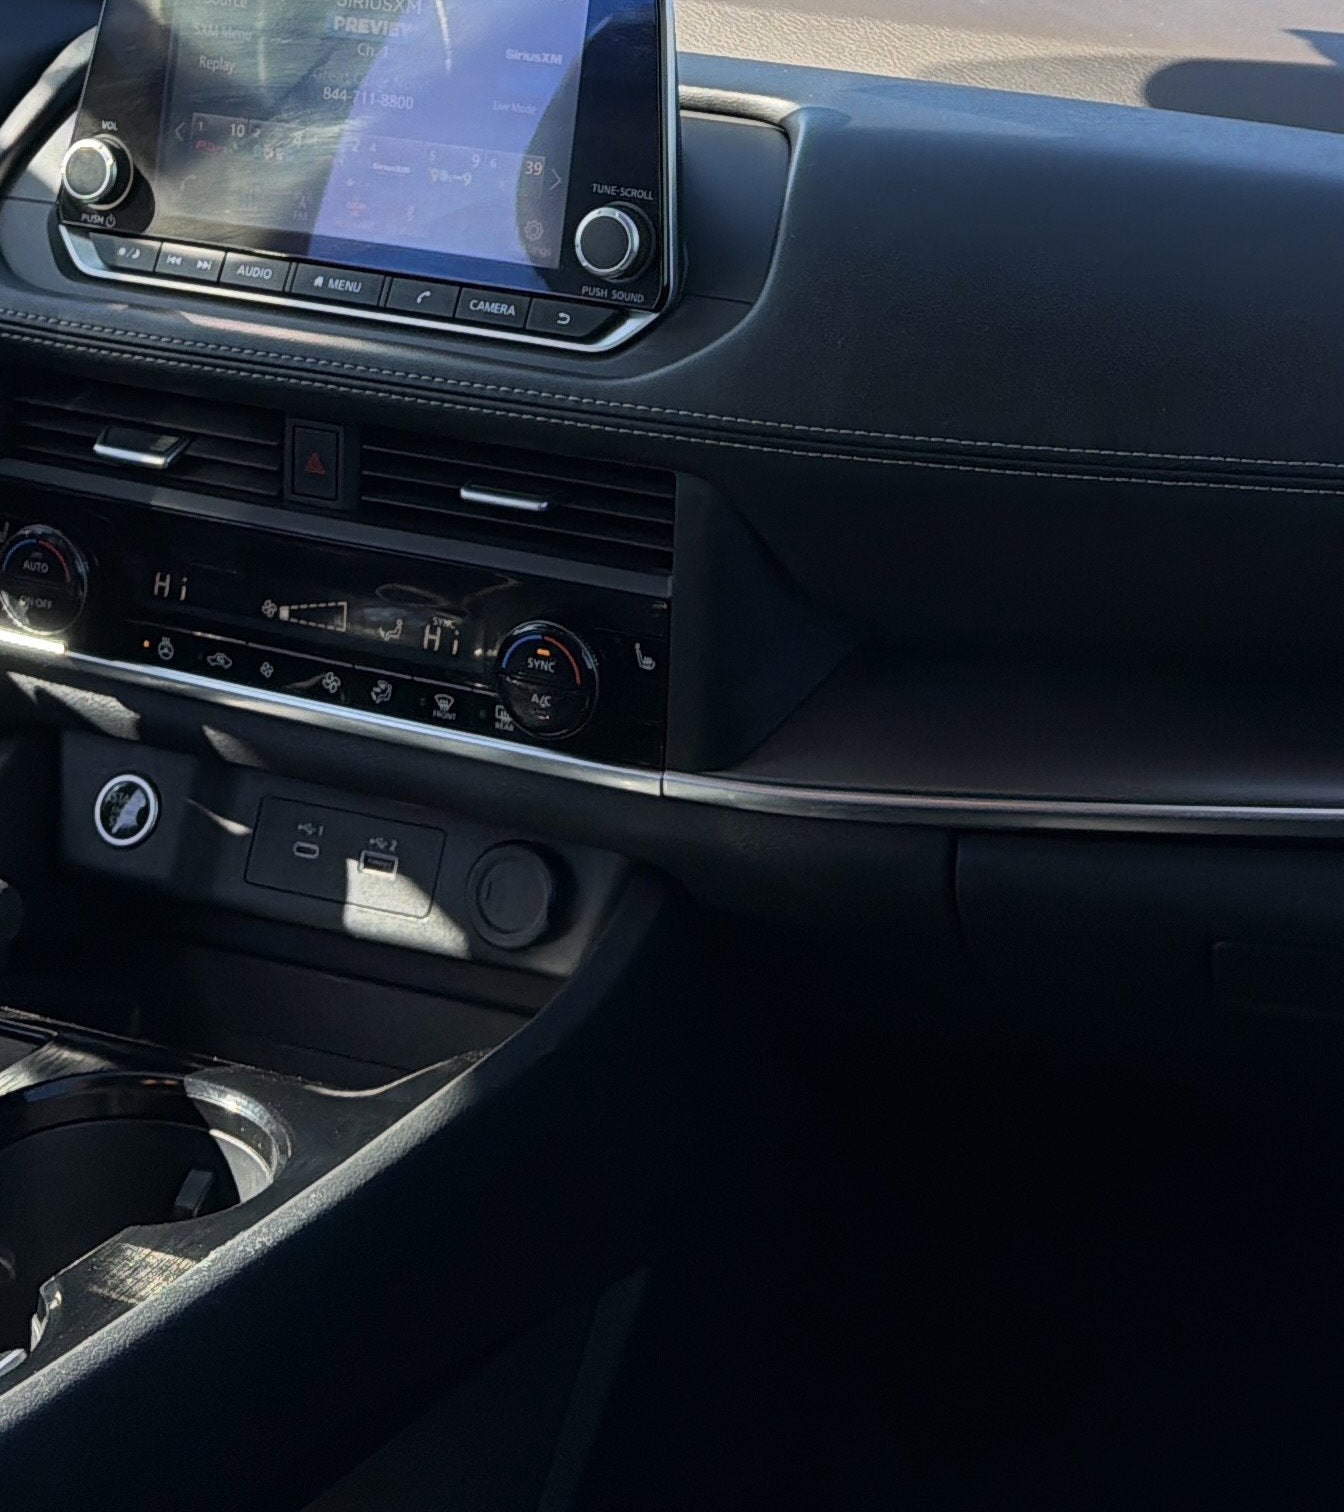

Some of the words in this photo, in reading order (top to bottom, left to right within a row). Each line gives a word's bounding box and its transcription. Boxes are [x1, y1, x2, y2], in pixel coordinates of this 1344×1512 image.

[199, 56, 236, 75] Replay
[322, 87, 415, 111] 844-711-8800
[102, 120, 118, 132] VOL
[230, 123, 245, 138] 10
[524, 160, 544, 176] 39
[81, 213, 105, 225] PUSH
[236, 264, 273, 281] AUDIO
[327, 277, 362, 294] MENU
[581, 285, 608, 298] PUSH
[611, 290, 645, 304] SOUND
[469, 299, 516, 317] CAMERA
[22, 559, 49, 574] AUTO
[153, 571, 189, 602] Hi
[432, 616, 457, 629] SYNC
[422, 623, 460, 656] Hi
[526, 657, 557, 674] SYNC
[530, 691, 553, 707] A/C
[432, 709, 457, 722] FRONT
[494, 720, 515, 732] REAR
[317, 824, 324, 837] 1
[387, 838, 397, 851] 2
